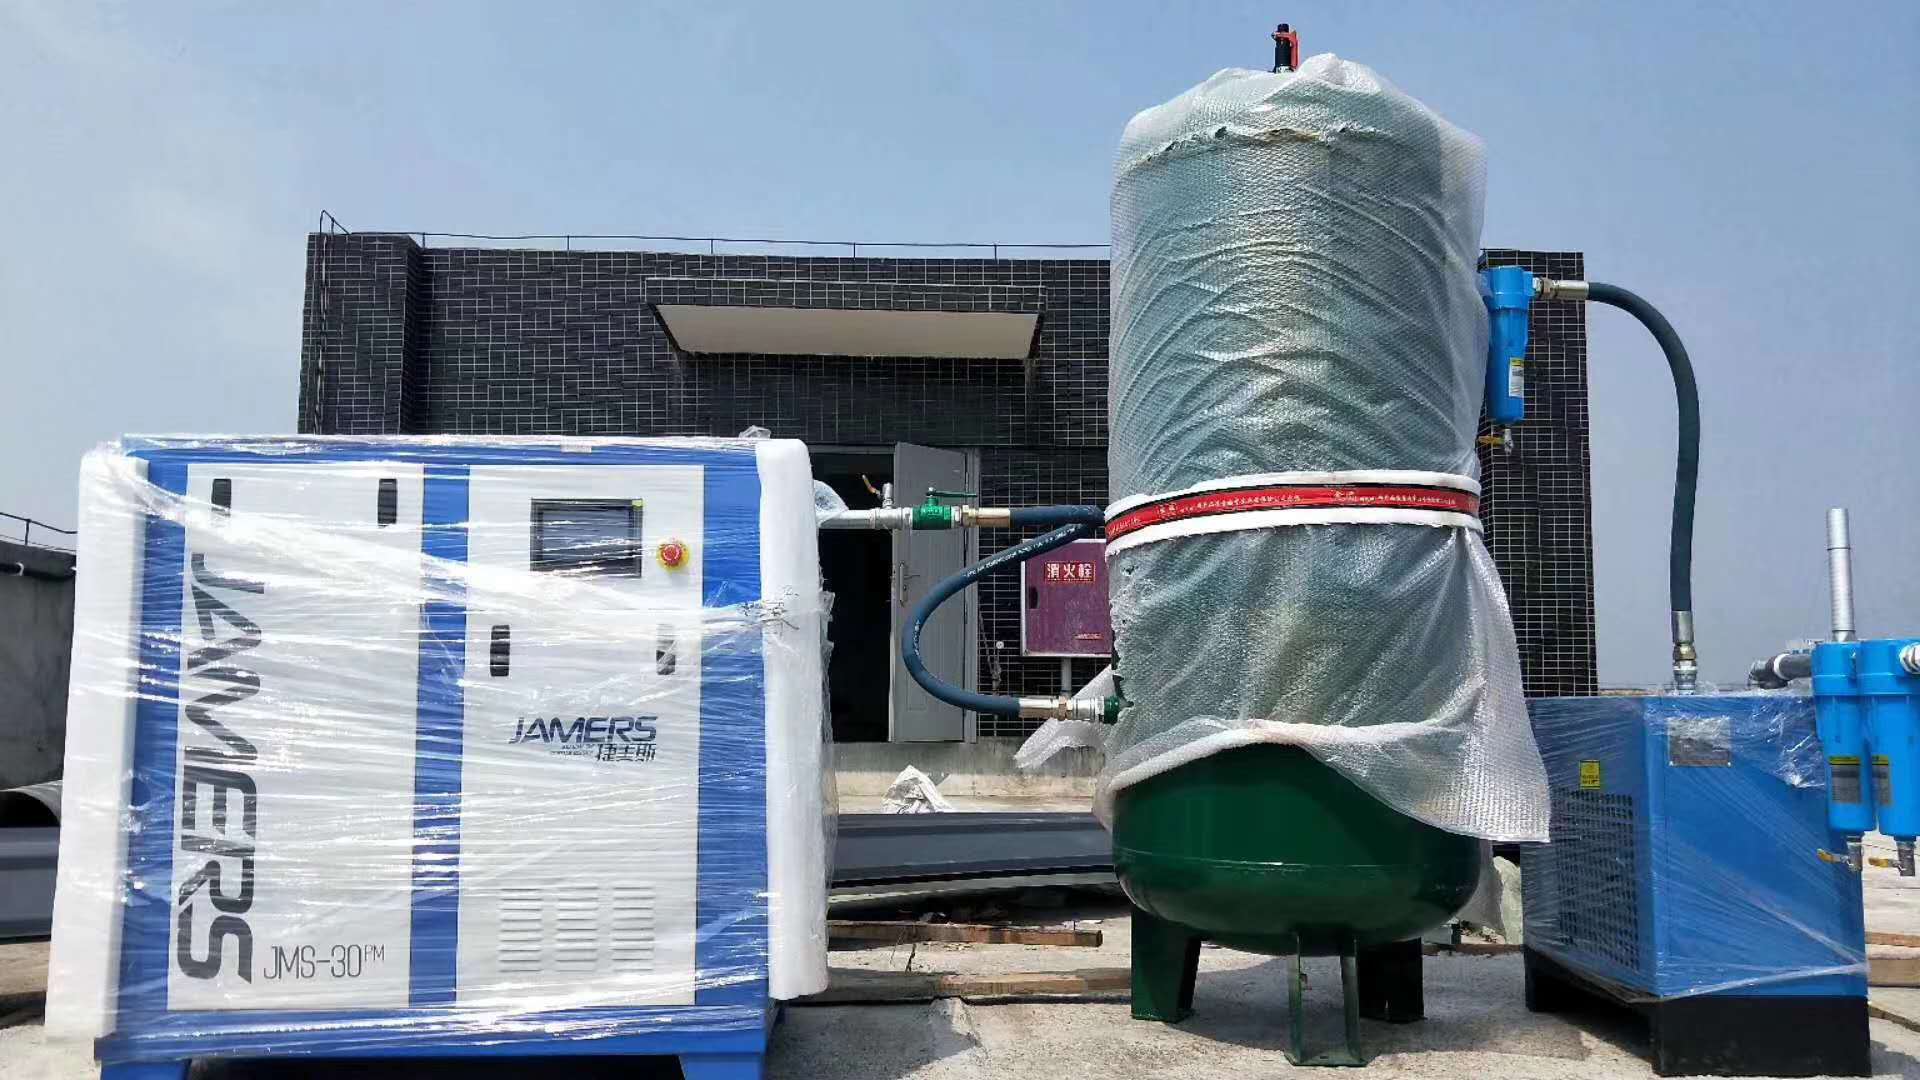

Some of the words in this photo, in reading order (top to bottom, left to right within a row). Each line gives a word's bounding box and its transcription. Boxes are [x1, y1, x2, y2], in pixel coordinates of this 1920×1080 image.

[1046, 562, 1093, 579] 消火栓
[508, 715, 659, 744] JAMERS
[176, 552, 265, 985] JAMERS
